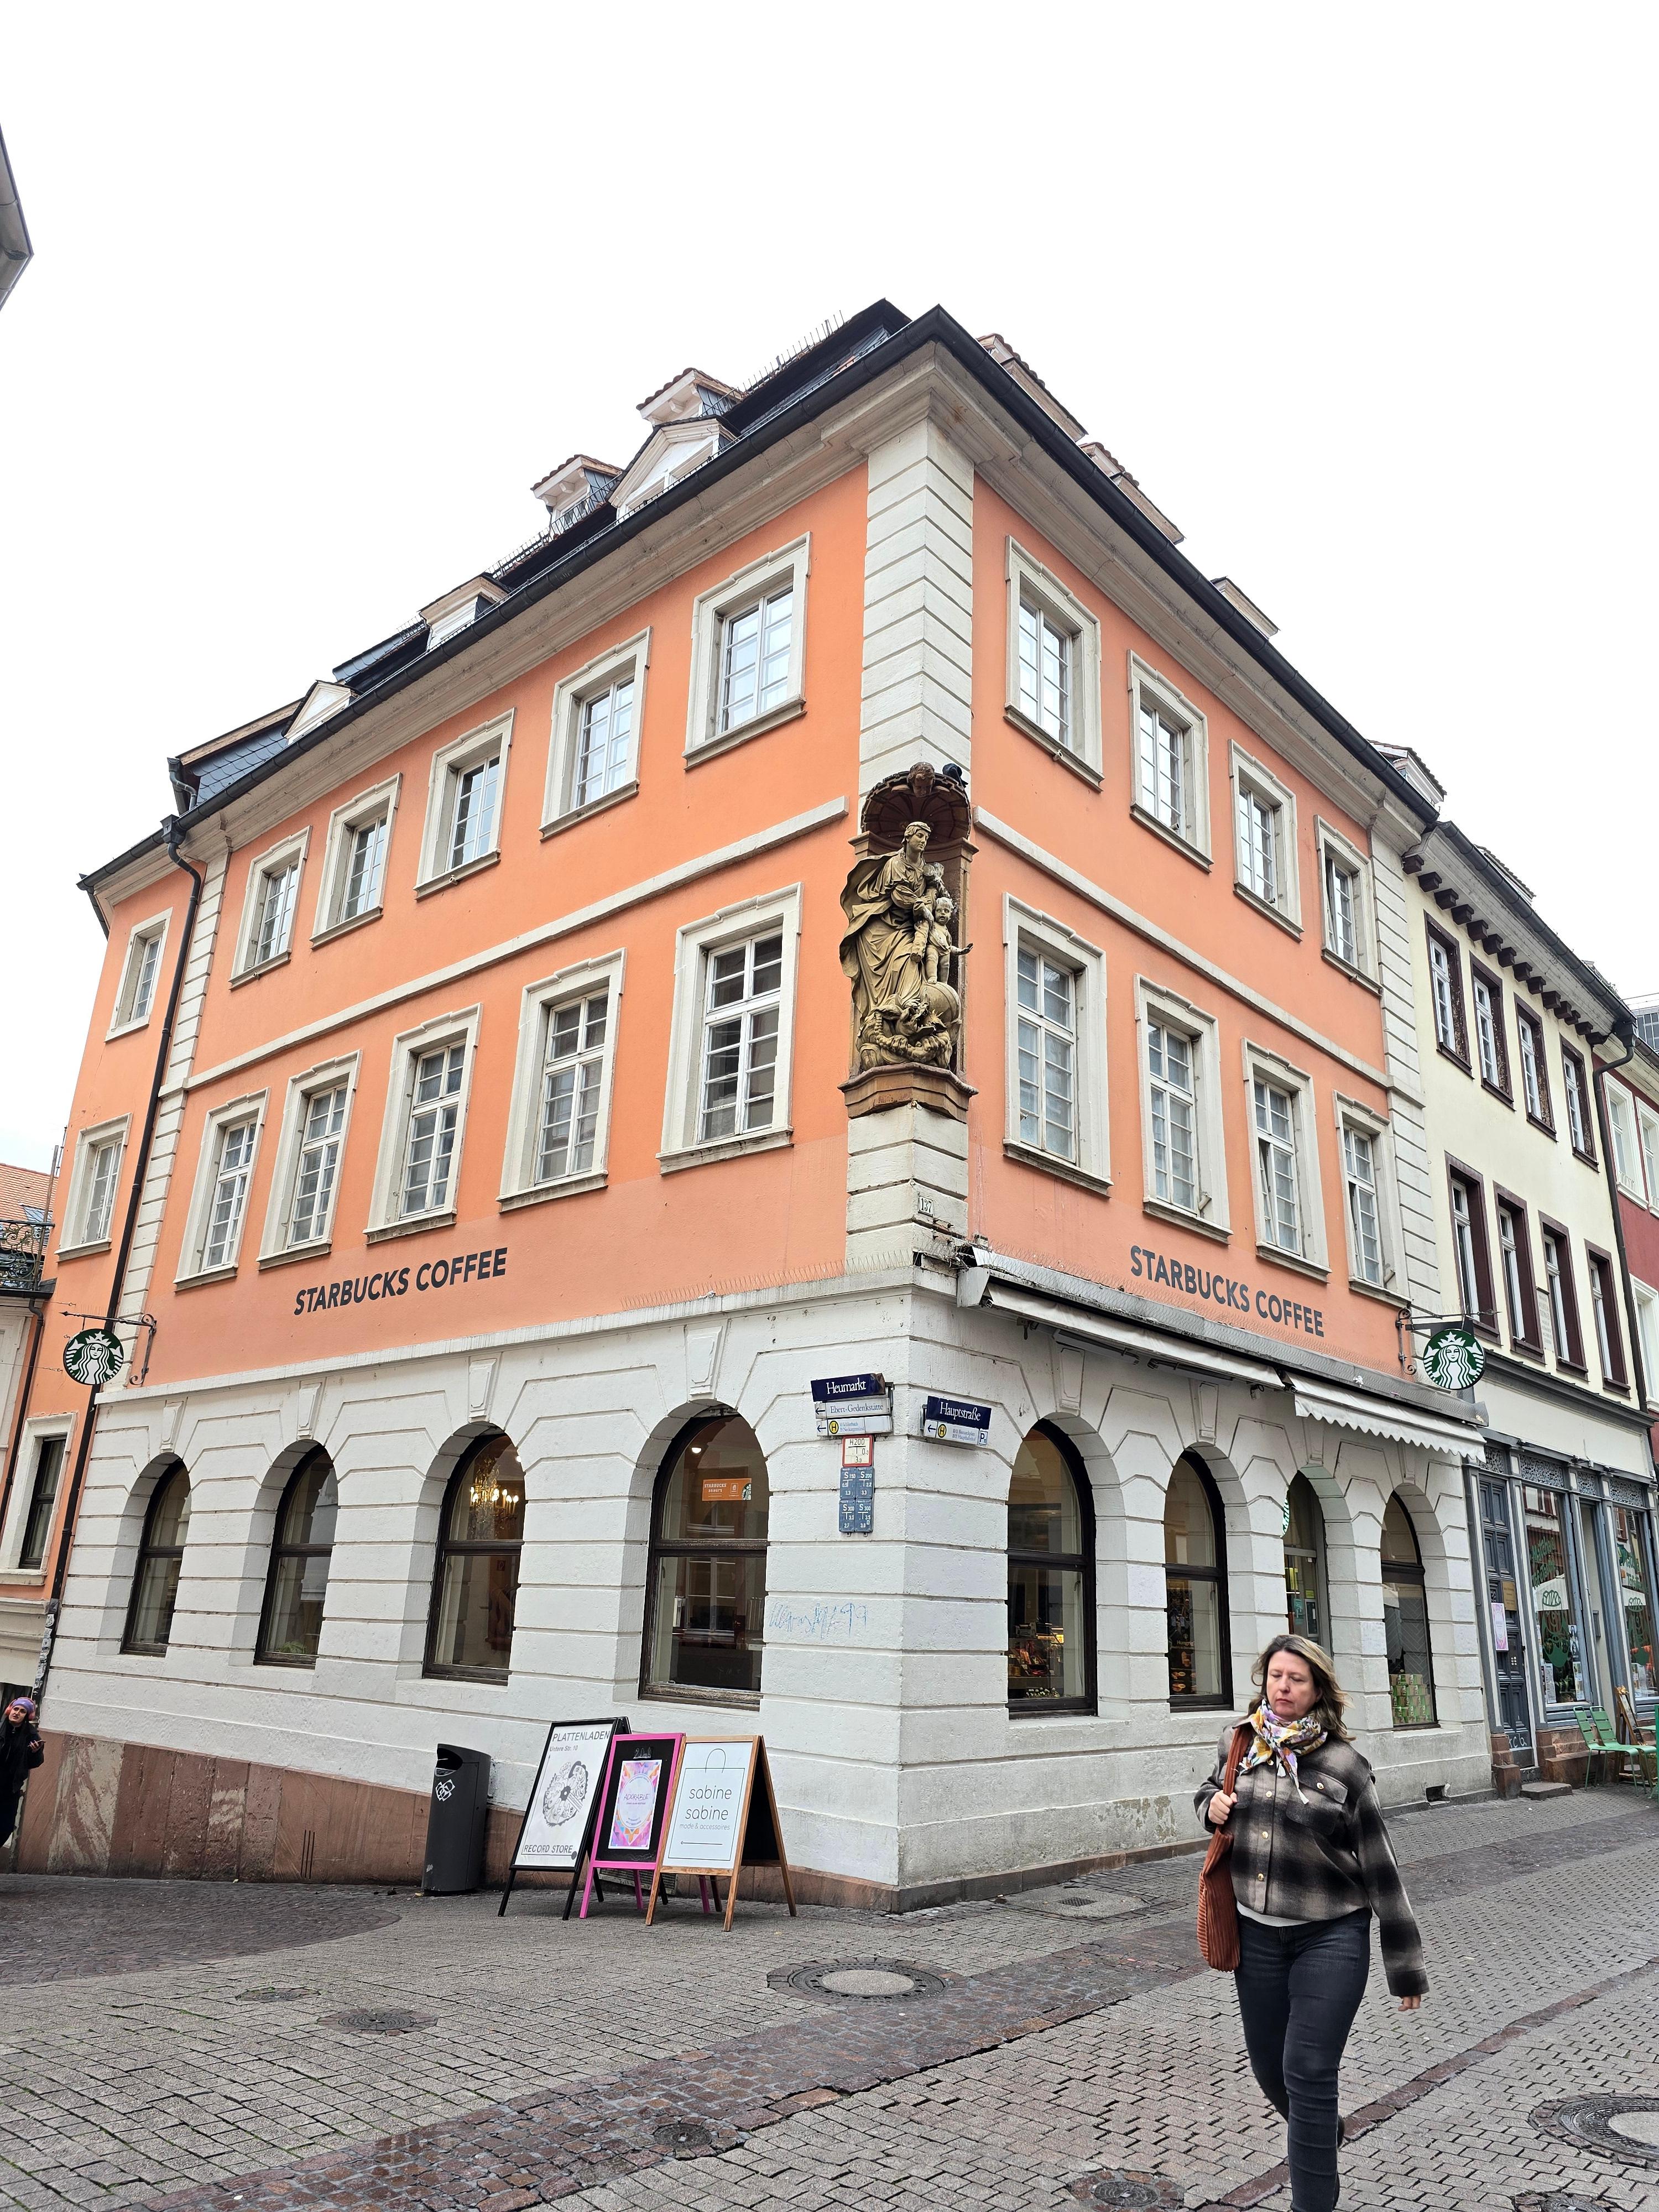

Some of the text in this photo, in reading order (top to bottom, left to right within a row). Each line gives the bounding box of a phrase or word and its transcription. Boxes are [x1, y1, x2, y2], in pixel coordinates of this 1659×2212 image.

[921, 1198, 932, 1213] 137
[294, 1247, 508, 1316] STARBUCKS COFFEE
[1130, 1245, 1324, 1338] STARBUCKS COFFEE
[826, 1377, 867, 1395] Heumarkt
[940, 1401, 981, 1421] Hauptstraße
[552, 1730, 611, 1742] PLATTENLADEN
[689, 1785, 732, 1799] sabine
[685, 1804, 728, 1820] sabine
[524, 1844, 573, 1853] RECORD STORE
